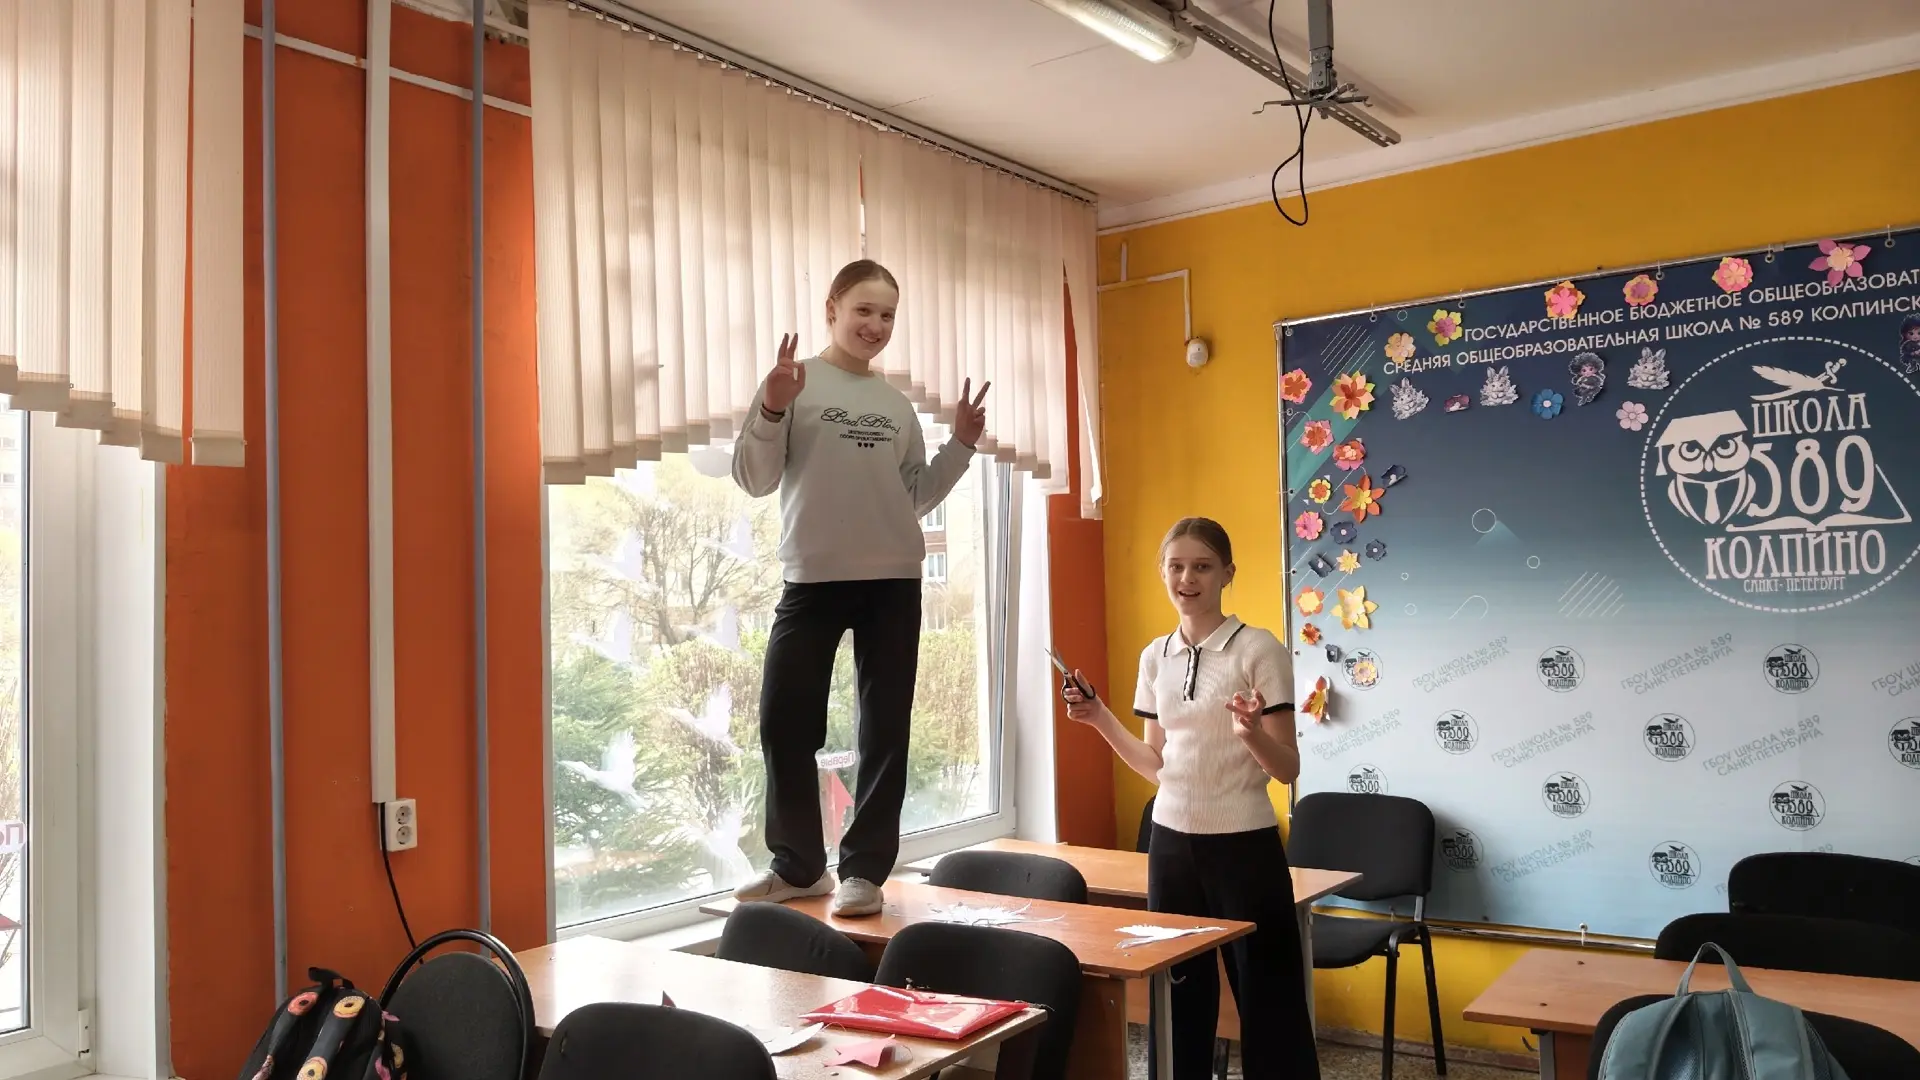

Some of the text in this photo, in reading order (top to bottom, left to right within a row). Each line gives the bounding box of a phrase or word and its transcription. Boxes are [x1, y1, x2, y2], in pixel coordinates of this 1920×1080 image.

[1464, 269, 1920, 342] ГОСУДАРСТВЕННОЕ БЮДЖЕТНОЕ ОБЩЕОБРАЗОВАТ
[1383, 354, 1451, 375] СРЕДНЯЯ
[1456, 328, 1659, 365] ОБЩЕОБРАЗОВАТЕЛЬНАЯ
[1665, 320, 1733, 340] ШКОЛА
[1739, 315, 1761, 330] №
[1768, 309, 1804, 327] 589
[1751, 393, 1871, 438] ШКОЛА
[1746, 435, 1875, 517] 589
[1704, 529, 1886, 580] КОЛПИНО
[1437, 653, 1474, 675] ШКОЛА
[1488, 636, 1508, 651] 589
[1634, 646, 1734, 694] САНКТ-ПЕТЕРБУРГА
[1650, 652, 1693, 677] ШКОЛА
[1710, 632, 1732, 649] 589
[1518, 728, 1557, 751] ШКОЛА
[1717, 728, 1824, 776] САНКТ-ПЕТЕРБУРГА
[1734, 733, 1780, 758] ШКОЛА
[1797, 714, 1820, 731] 589
